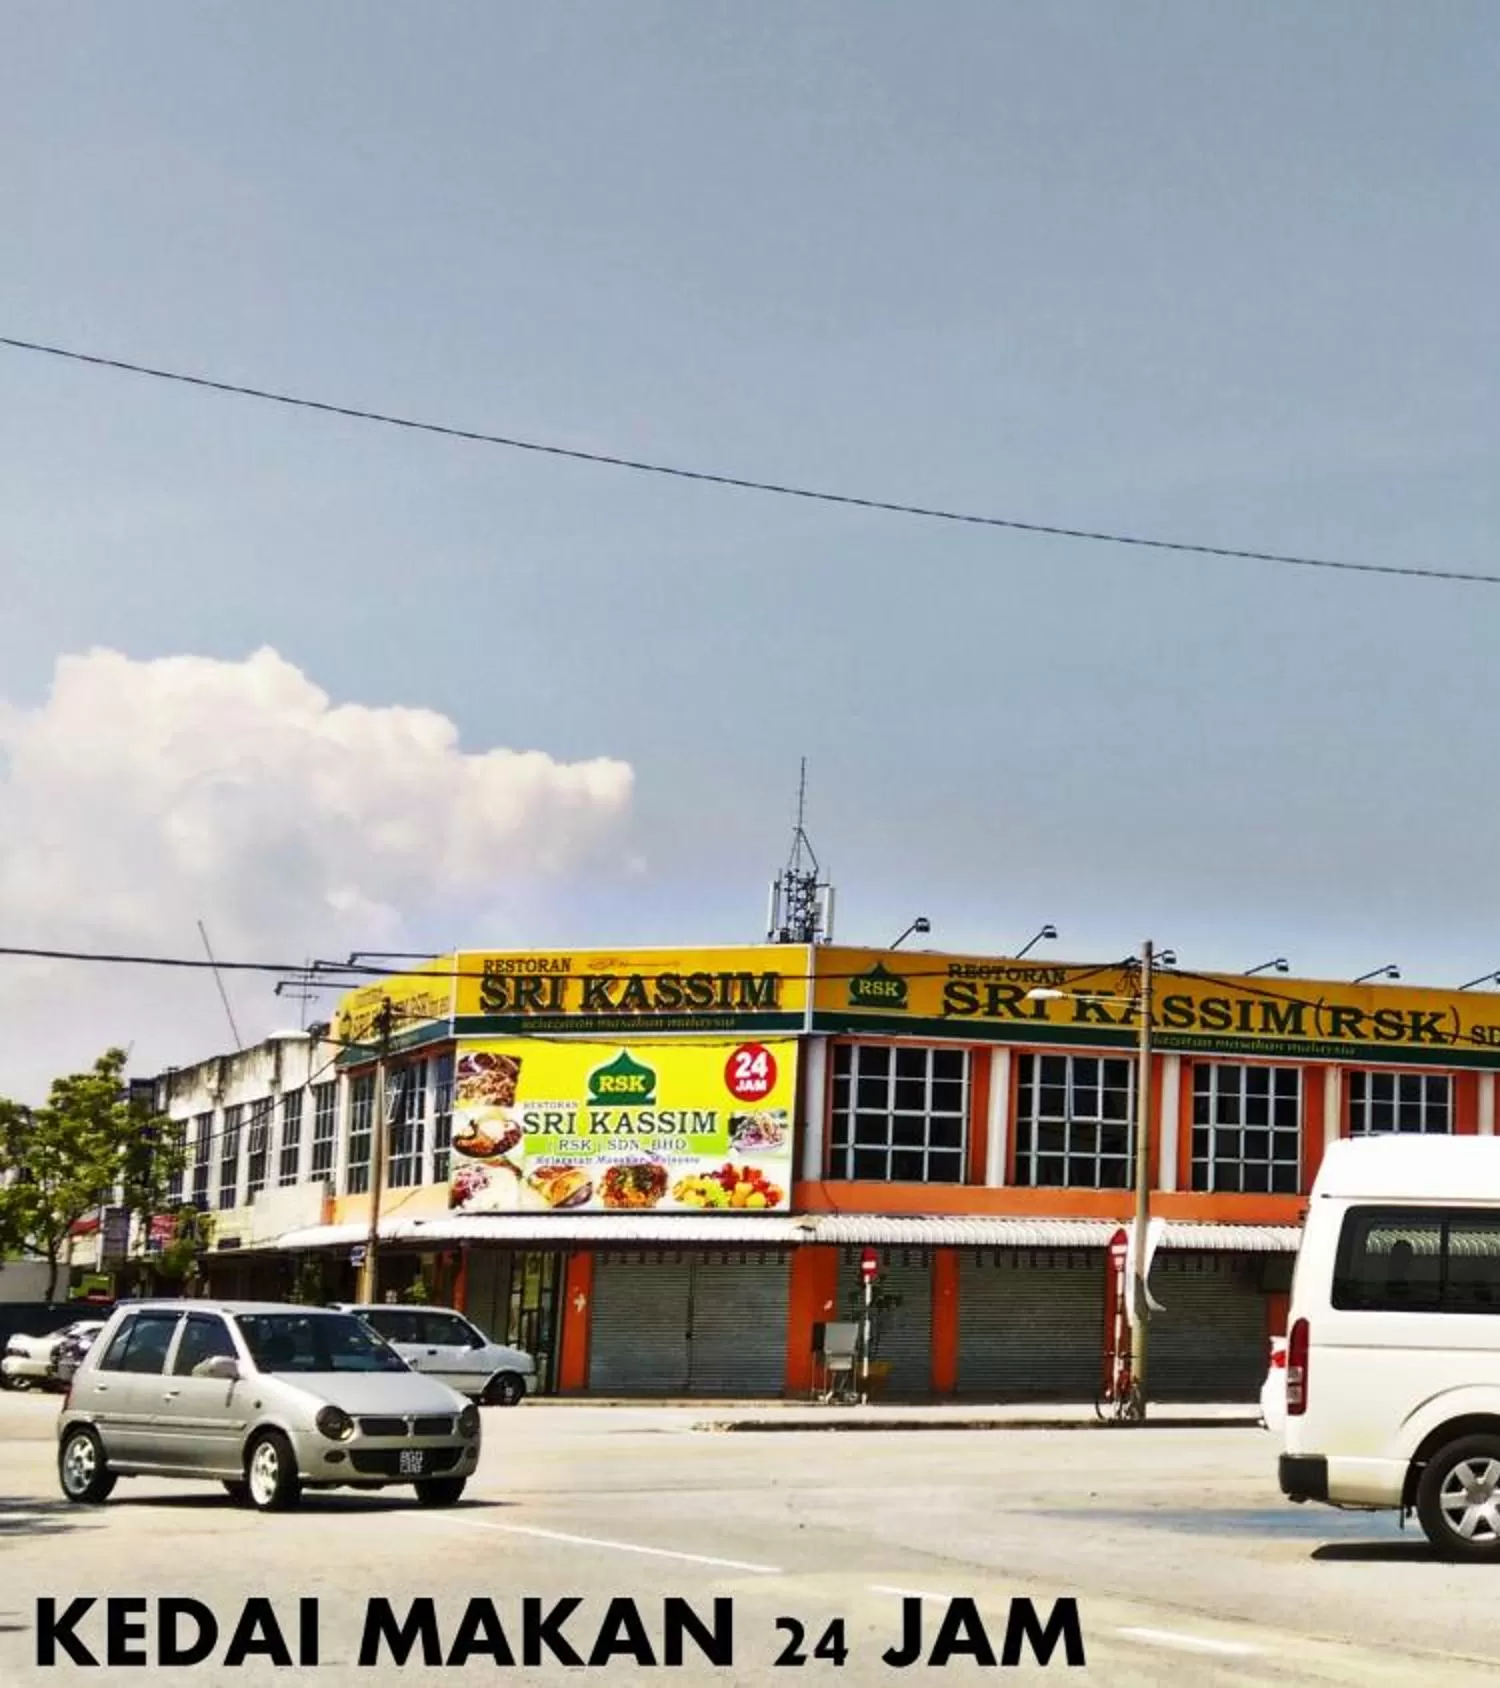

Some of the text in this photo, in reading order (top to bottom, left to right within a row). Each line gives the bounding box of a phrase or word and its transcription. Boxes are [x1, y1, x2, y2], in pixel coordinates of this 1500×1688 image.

[483, 957, 572, 974] RESTORAN
[947, 962, 1067, 986] RESTORAN
[479, 971, 783, 1011] SRI KASSIM
[858, 979, 900, 997] RSK
[943, 980, 1050, 1021] SRI
[734, 1050, 769, 1079] 24
[598, 1075, 647, 1093] RSK
[735, 1079, 768, 1092] JAM
[522, 1111, 718, 1135] SRI KASSIM
